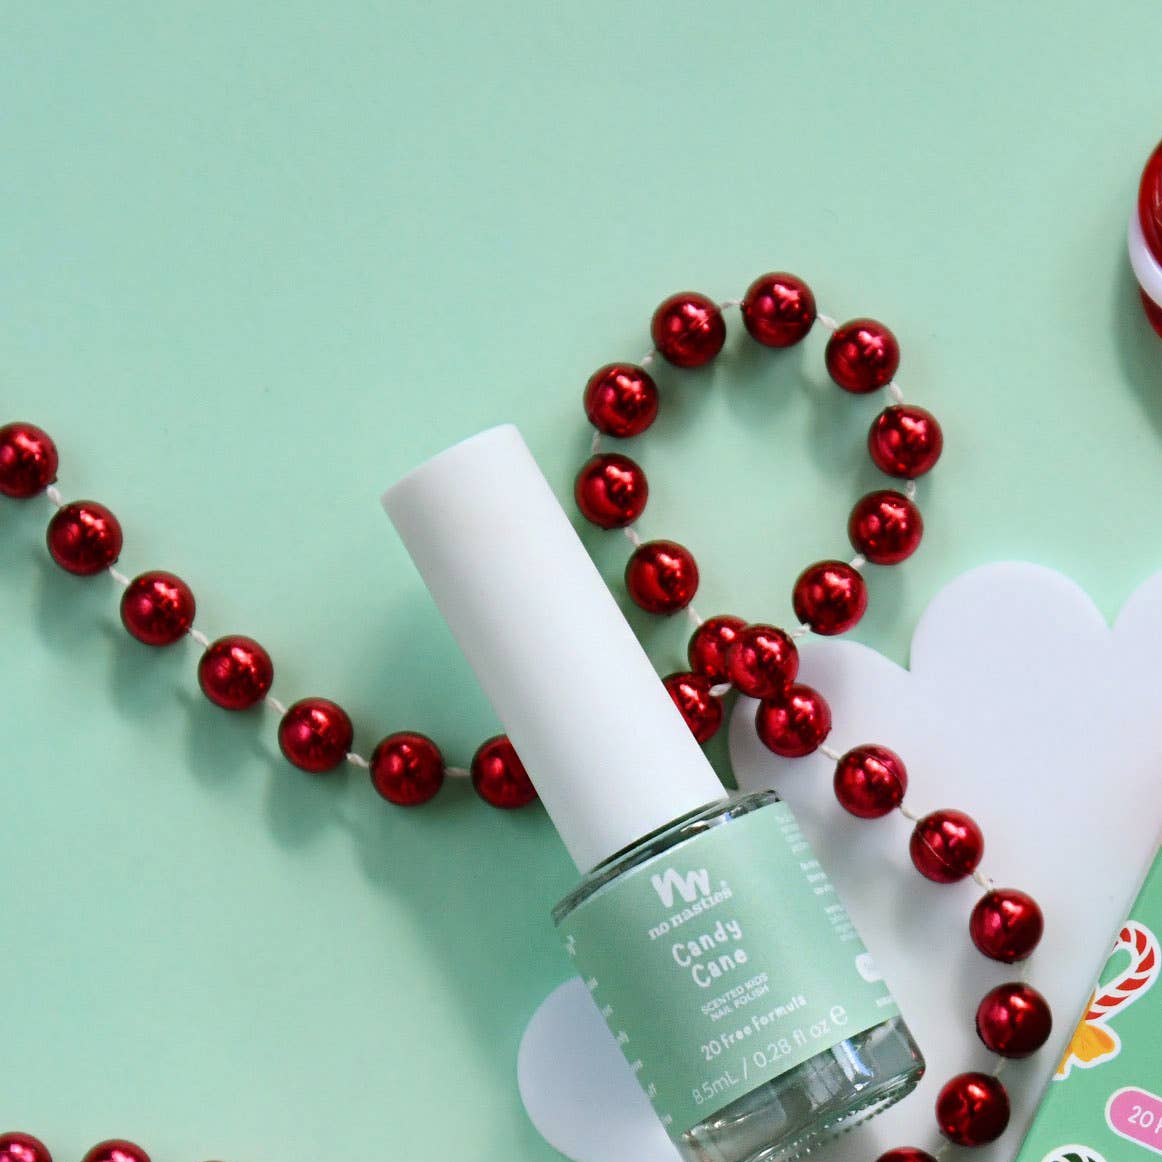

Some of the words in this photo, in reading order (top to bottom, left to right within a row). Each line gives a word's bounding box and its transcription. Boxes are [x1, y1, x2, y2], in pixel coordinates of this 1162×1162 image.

[648, 921, 670, 940] no
[672, 919, 743, 967] Candy
[691, 949, 747, 988] Cane
[692, 1070, 739, 1105] 8.5mL
[742, 1056, 748, 1081] /
[753, 1038, 792, 1068] 0.28
[793, 1028, 808, 1047] fl
[809, 1019, 832, 1039] oz
[701, 1040, 721, 1061] 20
[1128, 1105, 1154, 1128] 20
